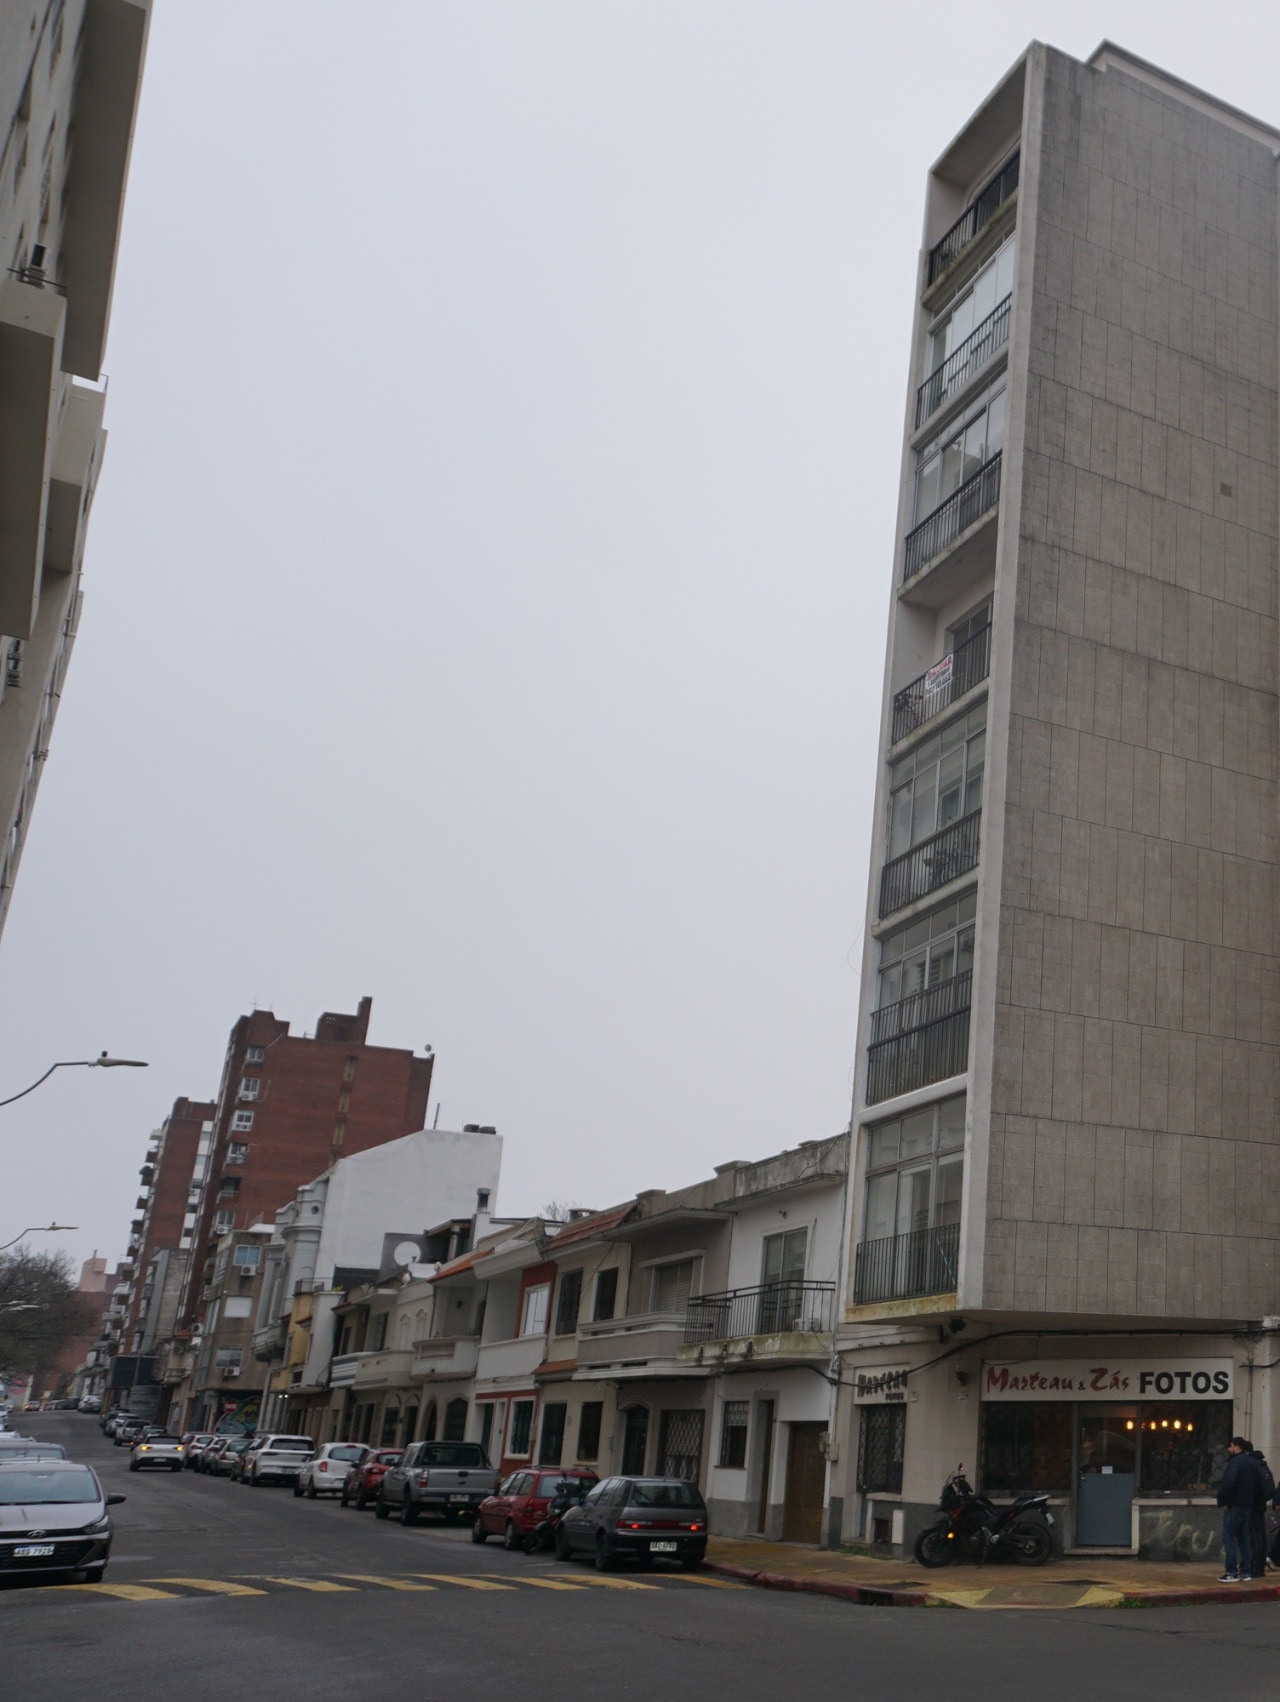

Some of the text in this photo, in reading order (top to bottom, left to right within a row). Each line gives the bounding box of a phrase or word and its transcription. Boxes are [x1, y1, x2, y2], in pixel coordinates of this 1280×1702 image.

[987, 1366, 1229, 1394] Marteau & Zás FOTOS
